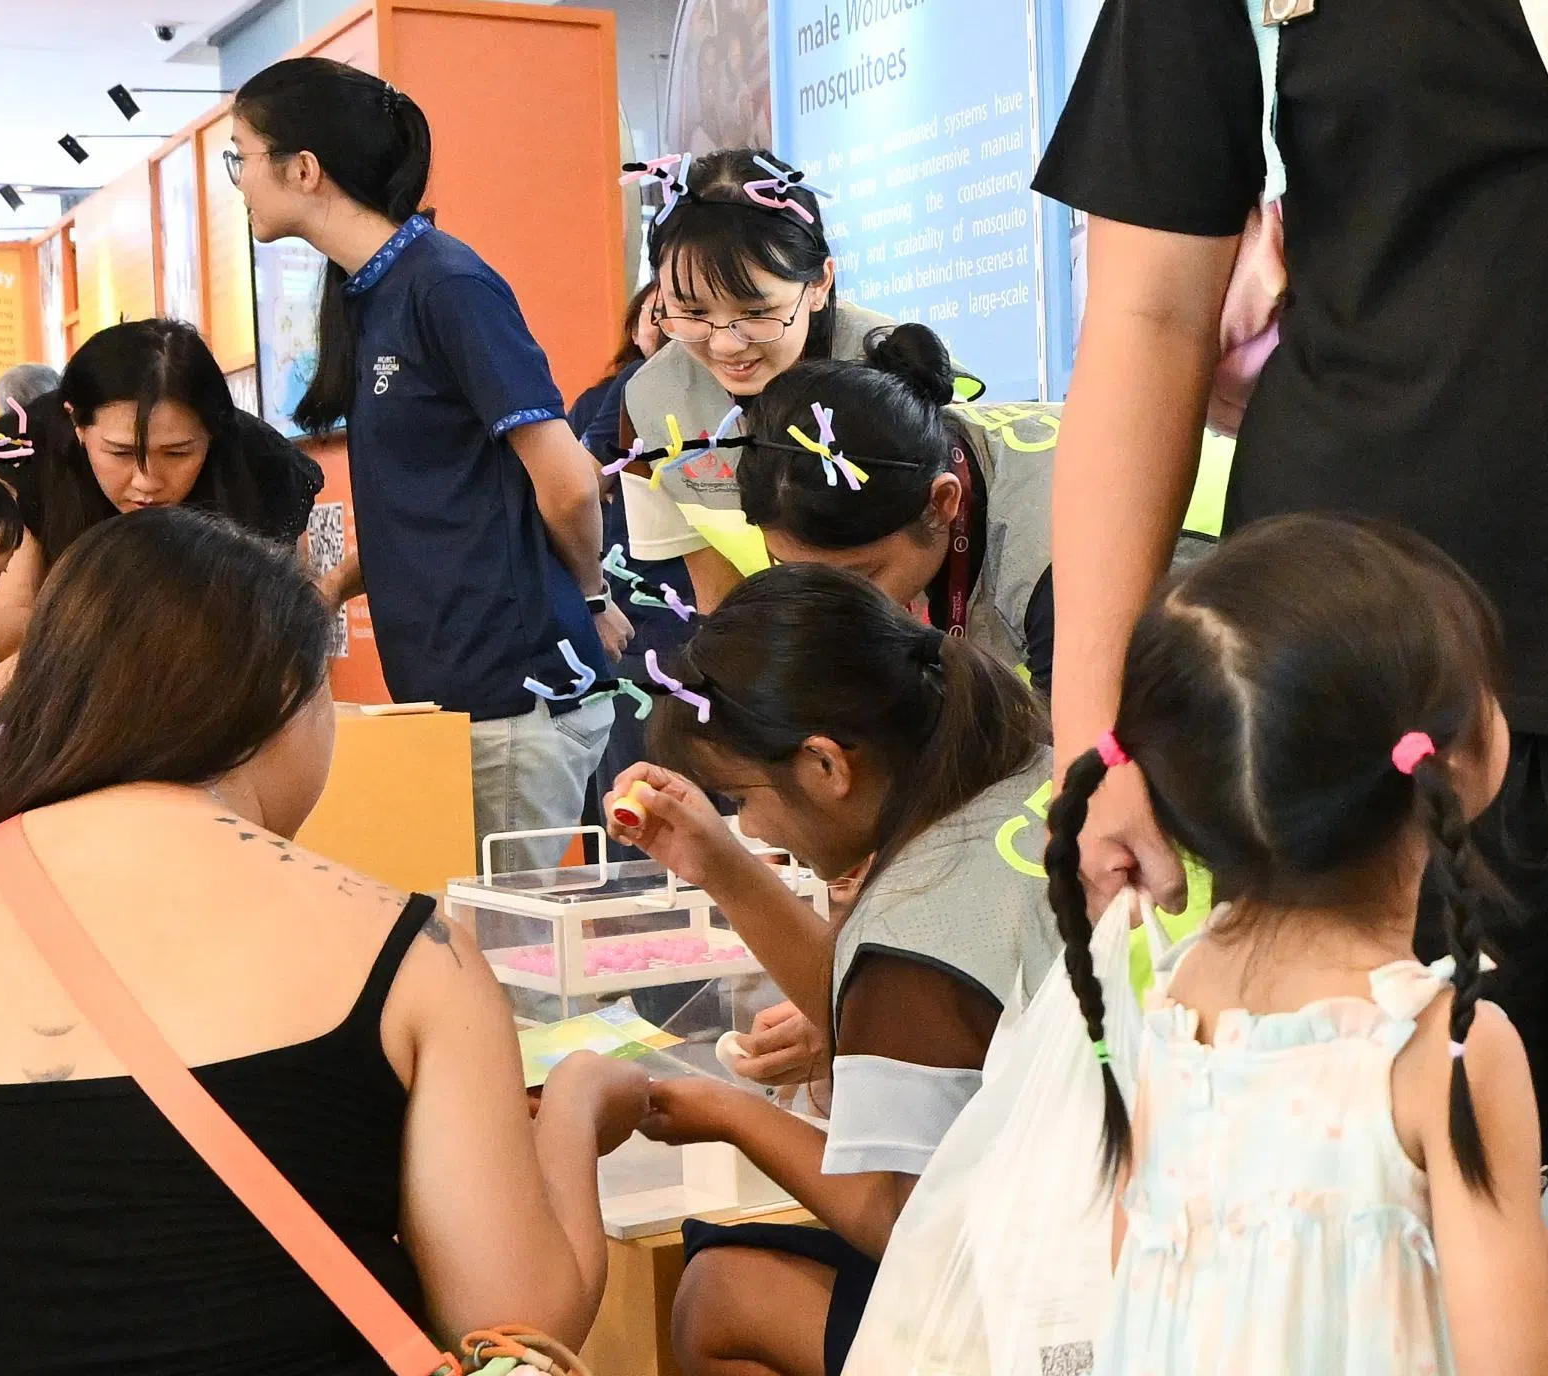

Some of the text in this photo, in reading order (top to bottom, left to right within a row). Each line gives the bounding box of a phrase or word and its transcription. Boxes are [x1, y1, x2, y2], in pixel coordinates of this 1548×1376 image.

[798, 5, 840, 56] male
[800, 47, 906, 115] mosquitoes
[994, 92, 1023, 116] have
[981, 125, 1023, 160] manual
[972, 208, 1026, 237] mosquito
